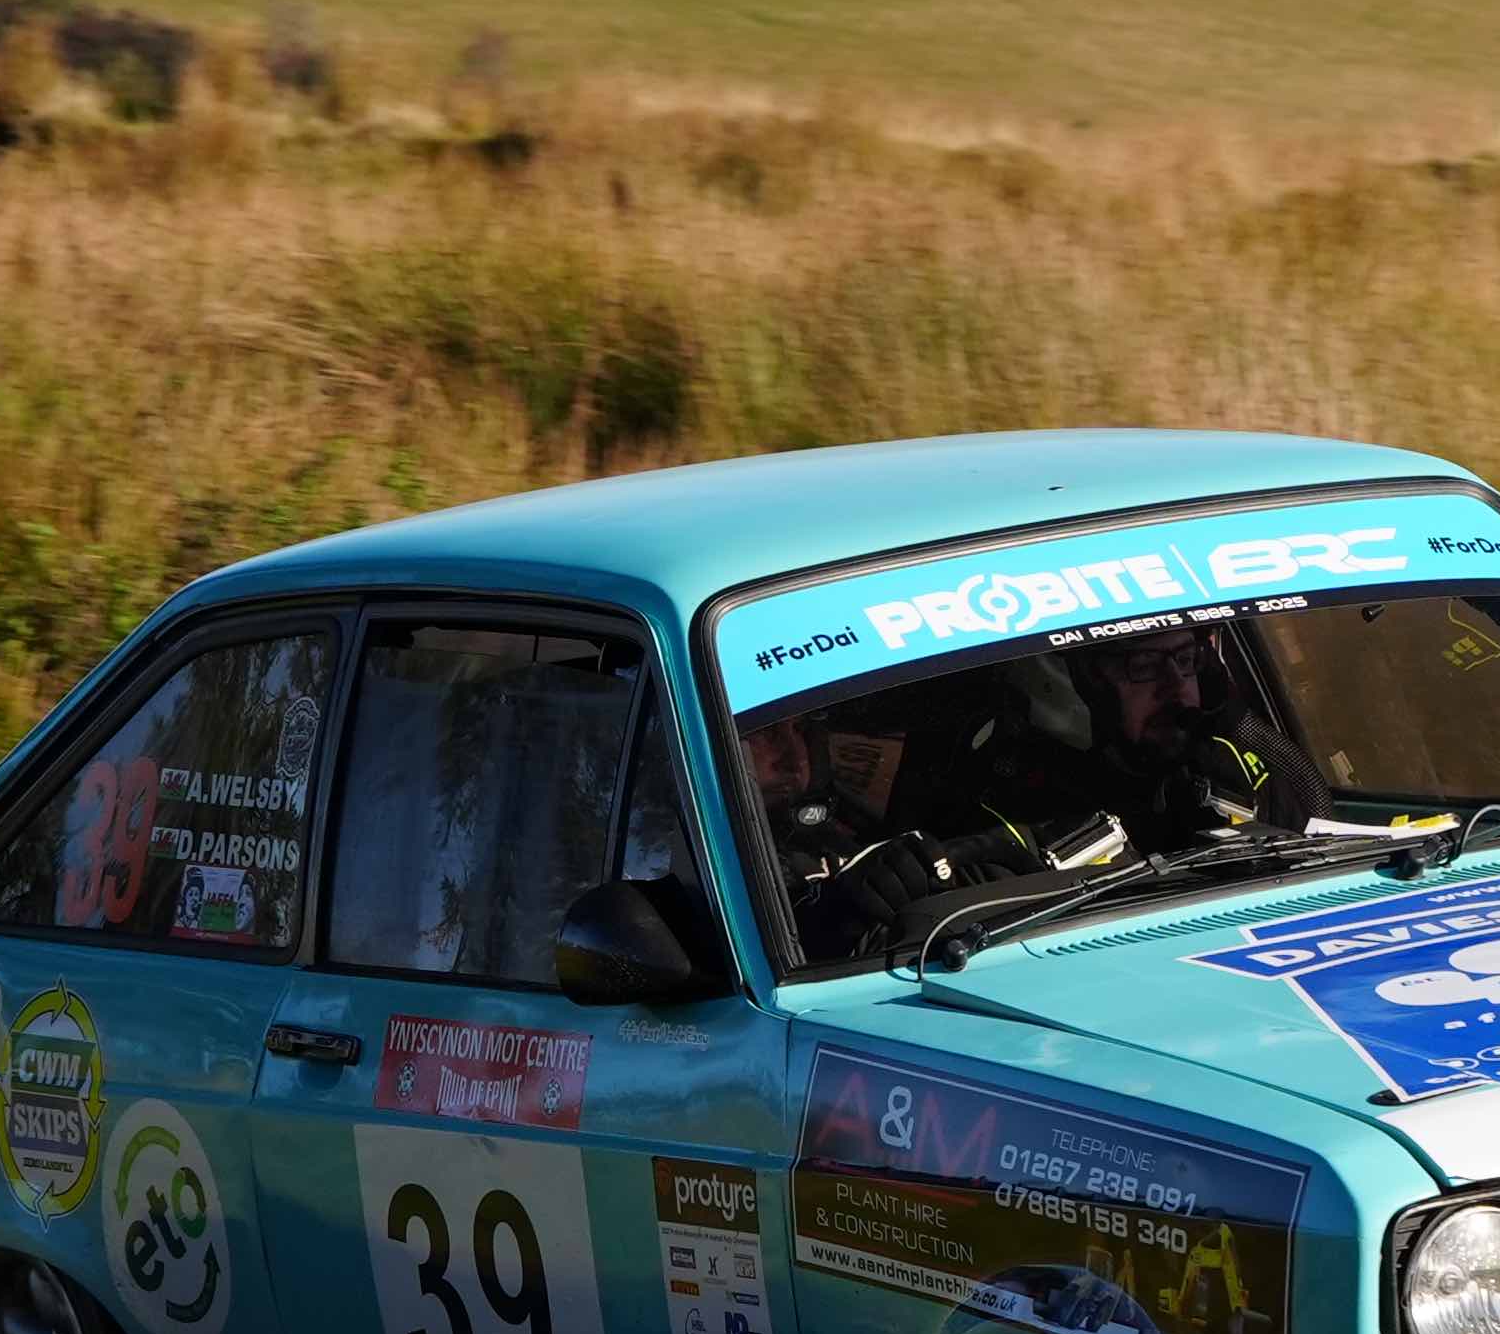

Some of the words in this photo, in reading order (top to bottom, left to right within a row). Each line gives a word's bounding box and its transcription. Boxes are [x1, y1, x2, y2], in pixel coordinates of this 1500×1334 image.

[863, 553, 1186, 650] PROBITE
[1207, 527, 1409, 588] BRC
[1049, 629, 1083, 647] DAI
[1091, 613, 1183, 640] ROBERTS
[1187, 605, 1235, 622] 1986
[1255, 596, 1308, 613] 2025
[755, 626, 859, 671] #ForDai
[186, 771, 299, 811] A.WELSBY
[64, 757, 158, 923] 39
[177, 829, 300, 871] D.PARSONS
[389, 1020, 484, 1059] YNYSCYNON
[485, 1032, 525, 1064] MOT
[526, 1036, 589, 1071] CENTRE
[1443, 1017, 1467, 1030] a
[17, 1049, 82, 1087] CWM
[437, 1065, 467, 1110] TOUR
[468, 1078, 485, 1107] OF
[485, 1074, 522, 1119] EPYNT
[12, 1104, 82, 1143] SKIPS
[1051, 1128, 1156, 1173] TELEPHONE:
[675, 1173, 756, 1221] protyre
[1000, 1144, 1079, 1186] 01267
[1086, 1167, 1139, 1203] 238
[1145, 1186, 1197, 1218] 091
[124, 1166, 207, 1292] eto
[835, 1182, 899, 1217] PLANT
[904, 1199, 949, 1229] HIRE
[815, 1207, 830, 1228] &
[834, 1211, 975, 1264] CONSTRUCTION
[1138, 1220, 1189, 1255] 340
[811, 1244, 1020, 1312] www.aandmplanthire.co.uk
